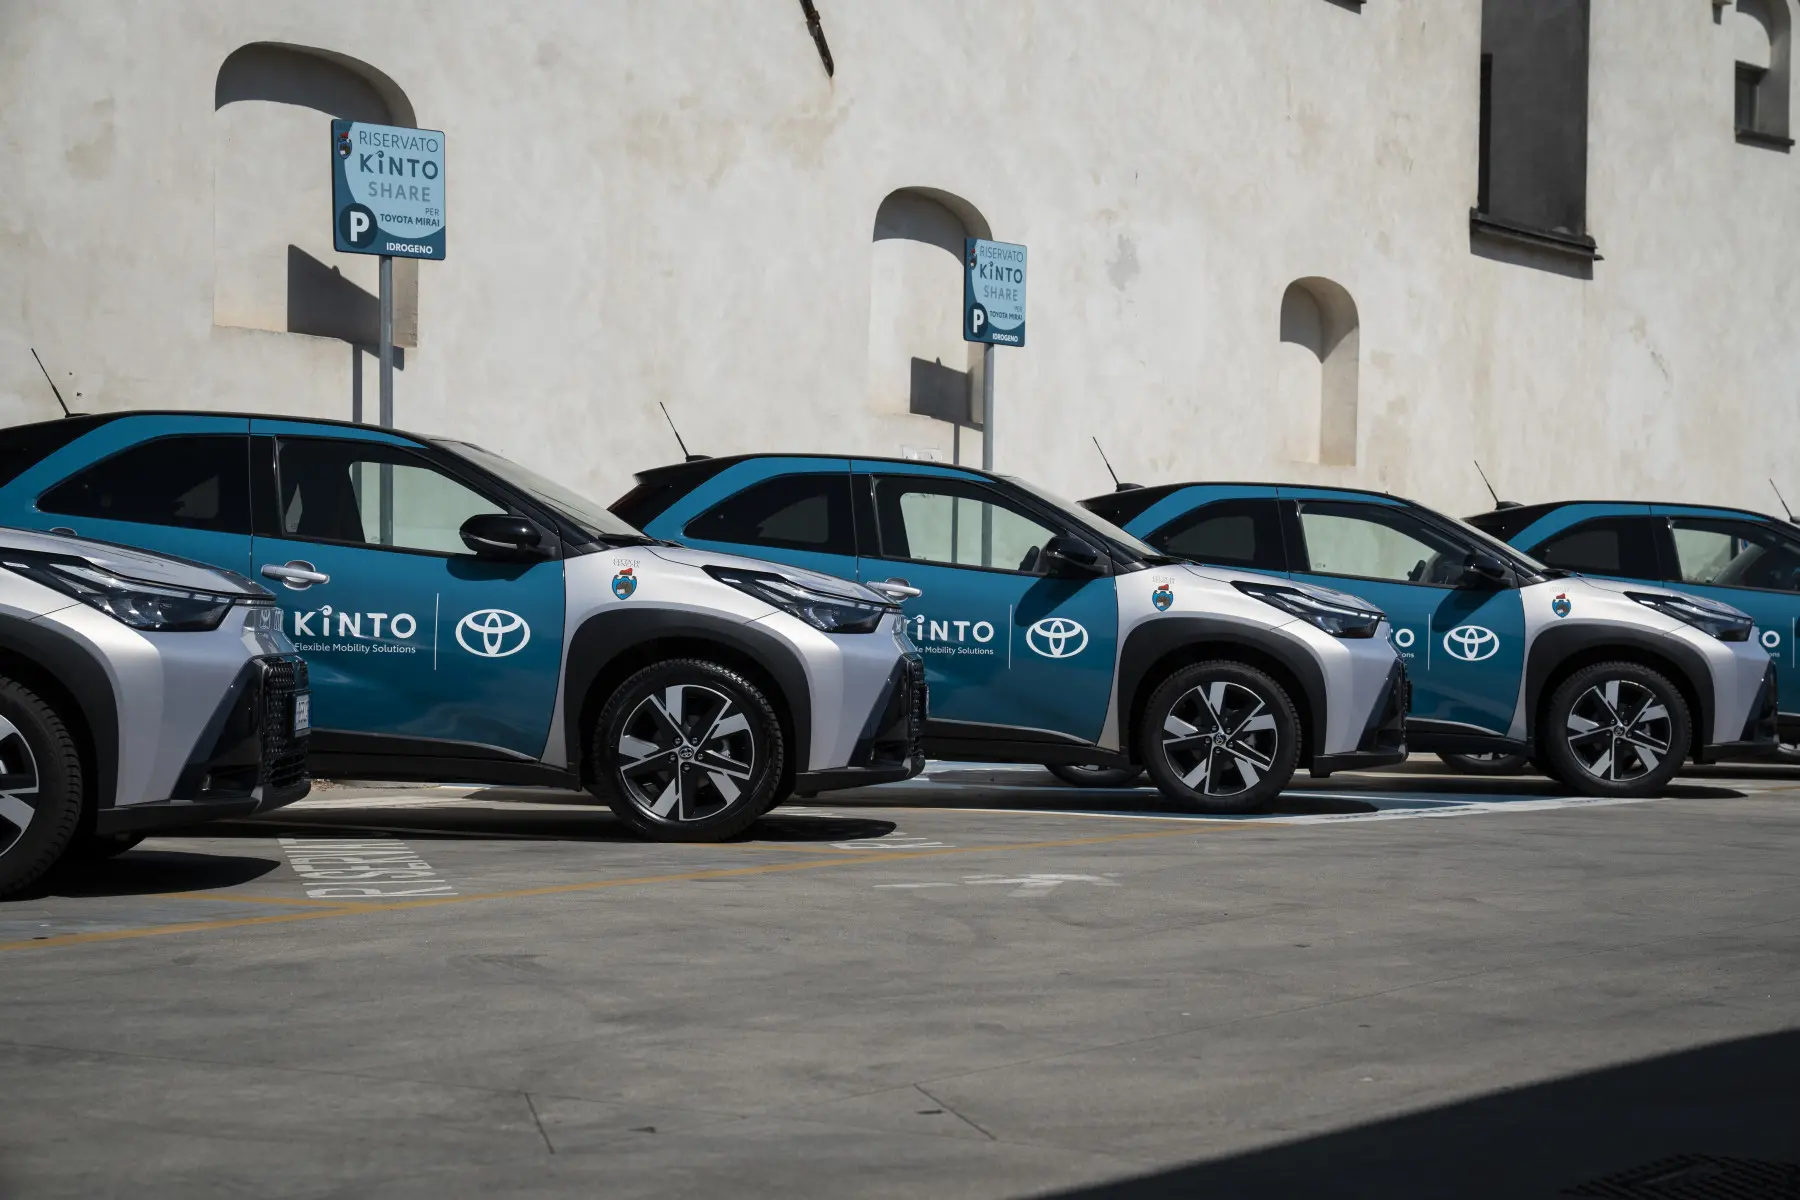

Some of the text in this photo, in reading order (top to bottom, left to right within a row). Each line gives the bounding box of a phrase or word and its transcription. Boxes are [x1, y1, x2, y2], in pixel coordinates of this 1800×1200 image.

[359, 130, 439, 153] RISERVATO
[368, 181, 431, 202] SHARE
[425, 207, 440, 216] PER
[349, 210, 370, 242] P
[380, 213, 440, 227] TOYOTA MIRAI
[386, 242, 433, 254] IDROGENO
[979, 246, 1023, 262] RISERVATO
[984, 285, 1018, 301] SHARE
[973, 308, 985, 333] P
[989, 310, 1008, 319] TOYOTA
[992, 333, 1018, 342] IDROGENO
[294, 642, 416, 655] Flexible Mobility Solutions
[924, 646, 956, 656] Mobility
[957, 647, 994, 655] Solutions
[277, 838, 459, 898] RISERVAT
